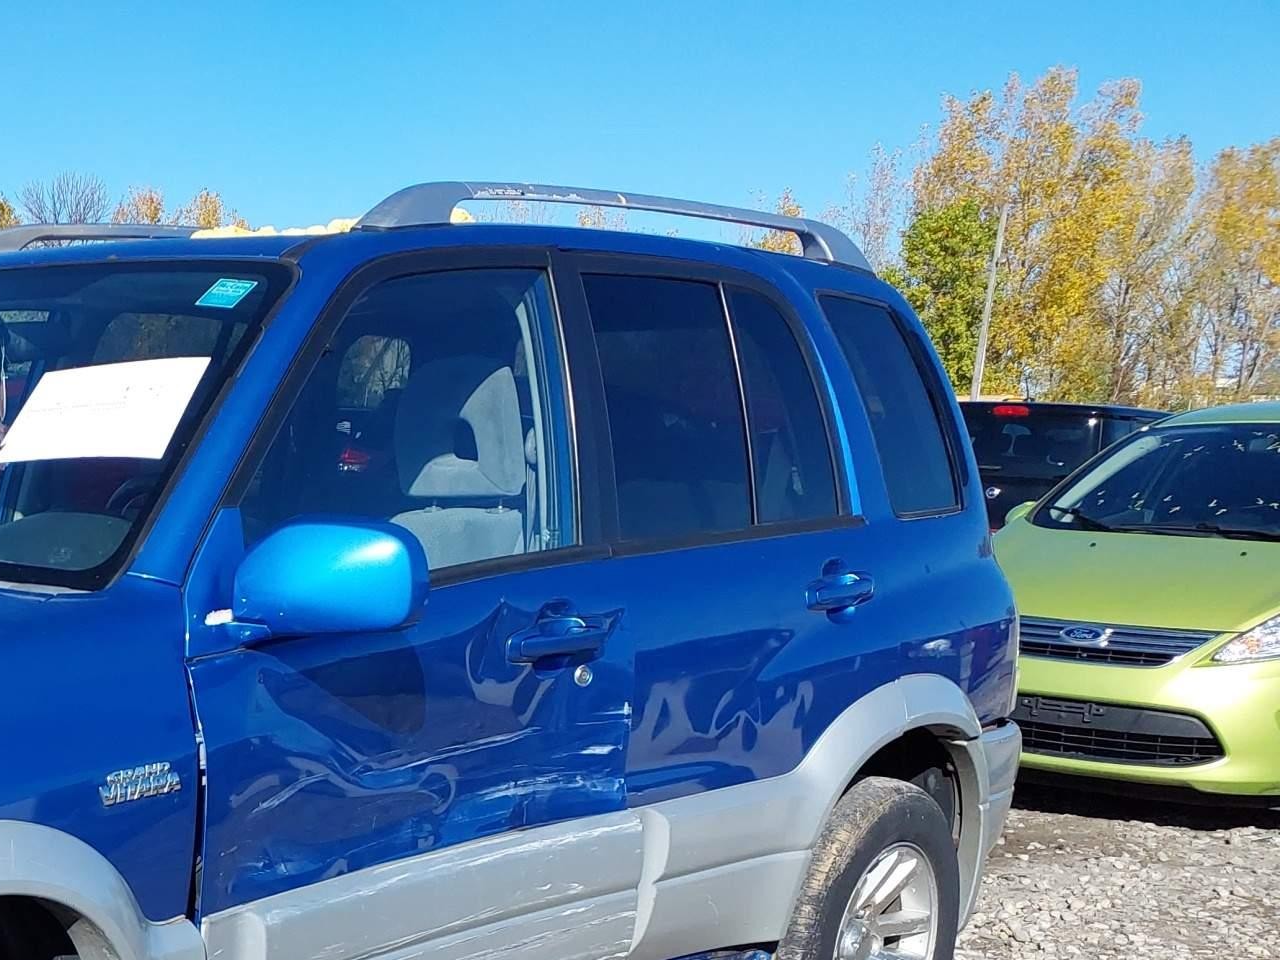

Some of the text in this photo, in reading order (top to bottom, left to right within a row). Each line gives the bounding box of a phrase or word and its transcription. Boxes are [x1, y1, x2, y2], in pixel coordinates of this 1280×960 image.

[1070, 629, 1095, 639] Ford
[106, 761, 171, 786] GRAND
[98, 771, 181, 807] VITARA
